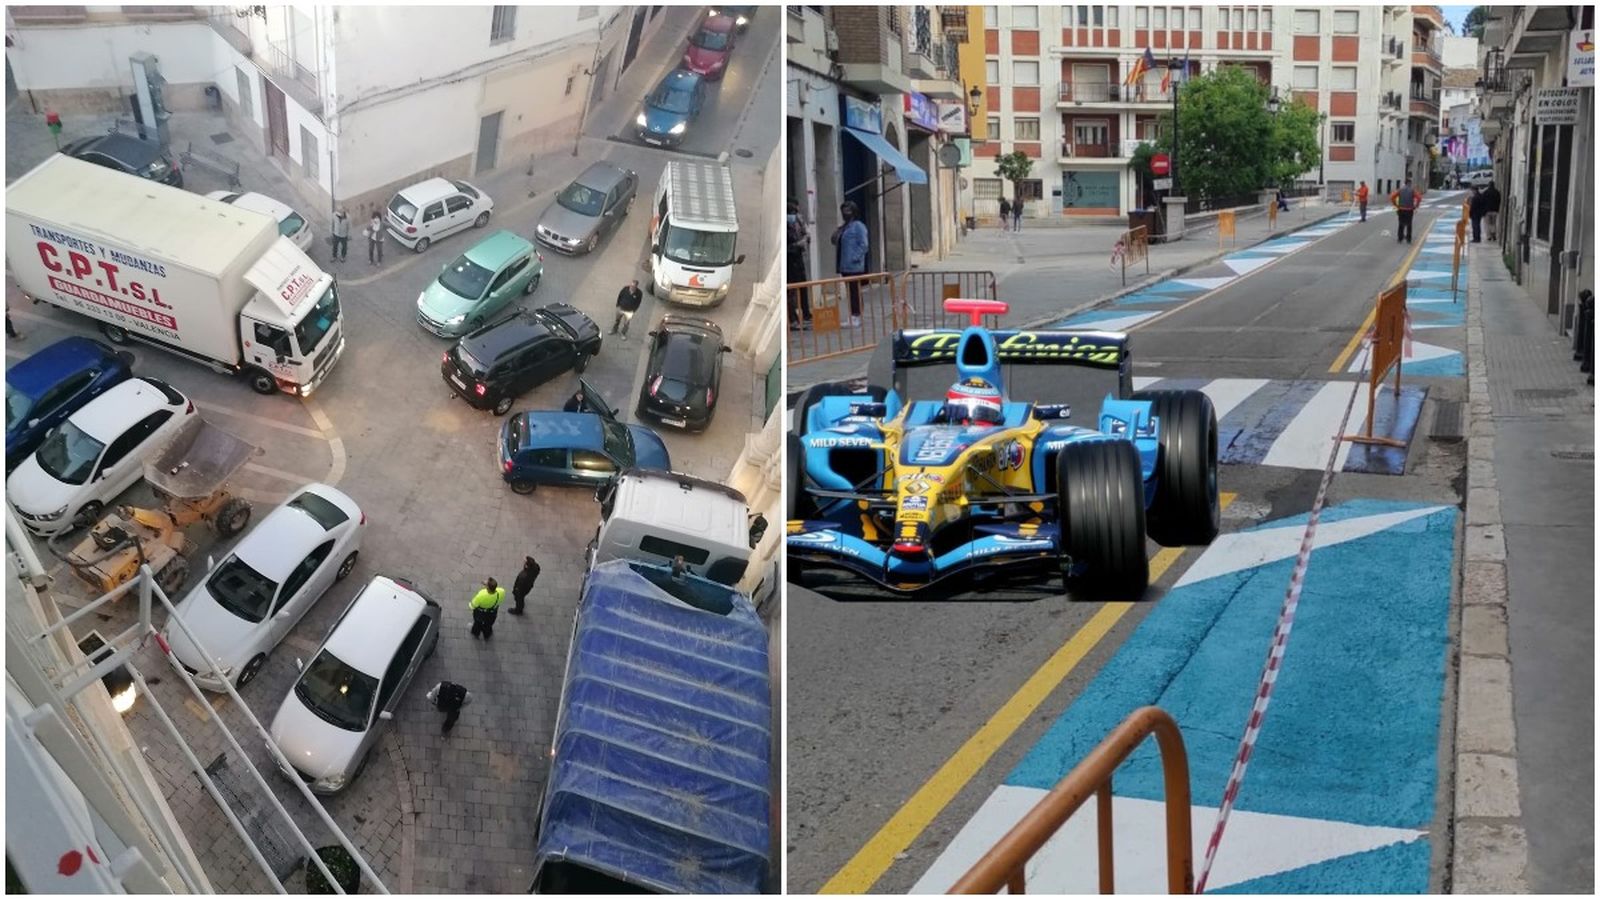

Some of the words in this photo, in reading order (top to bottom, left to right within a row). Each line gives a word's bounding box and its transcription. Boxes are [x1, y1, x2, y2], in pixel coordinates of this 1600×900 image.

[29, 224, 95, 255] TRANSPORTES
[99, 247, 106, 259] Y
[110, 250, 166, 278] MUDANZAS
[54, 280, 174, 328] GUARDAMUEBLES
[133, 319, 181, 341] VALENCIA
[810, 438, 837, 448] MILD
[838, 437, 873, 448] SEVEN
